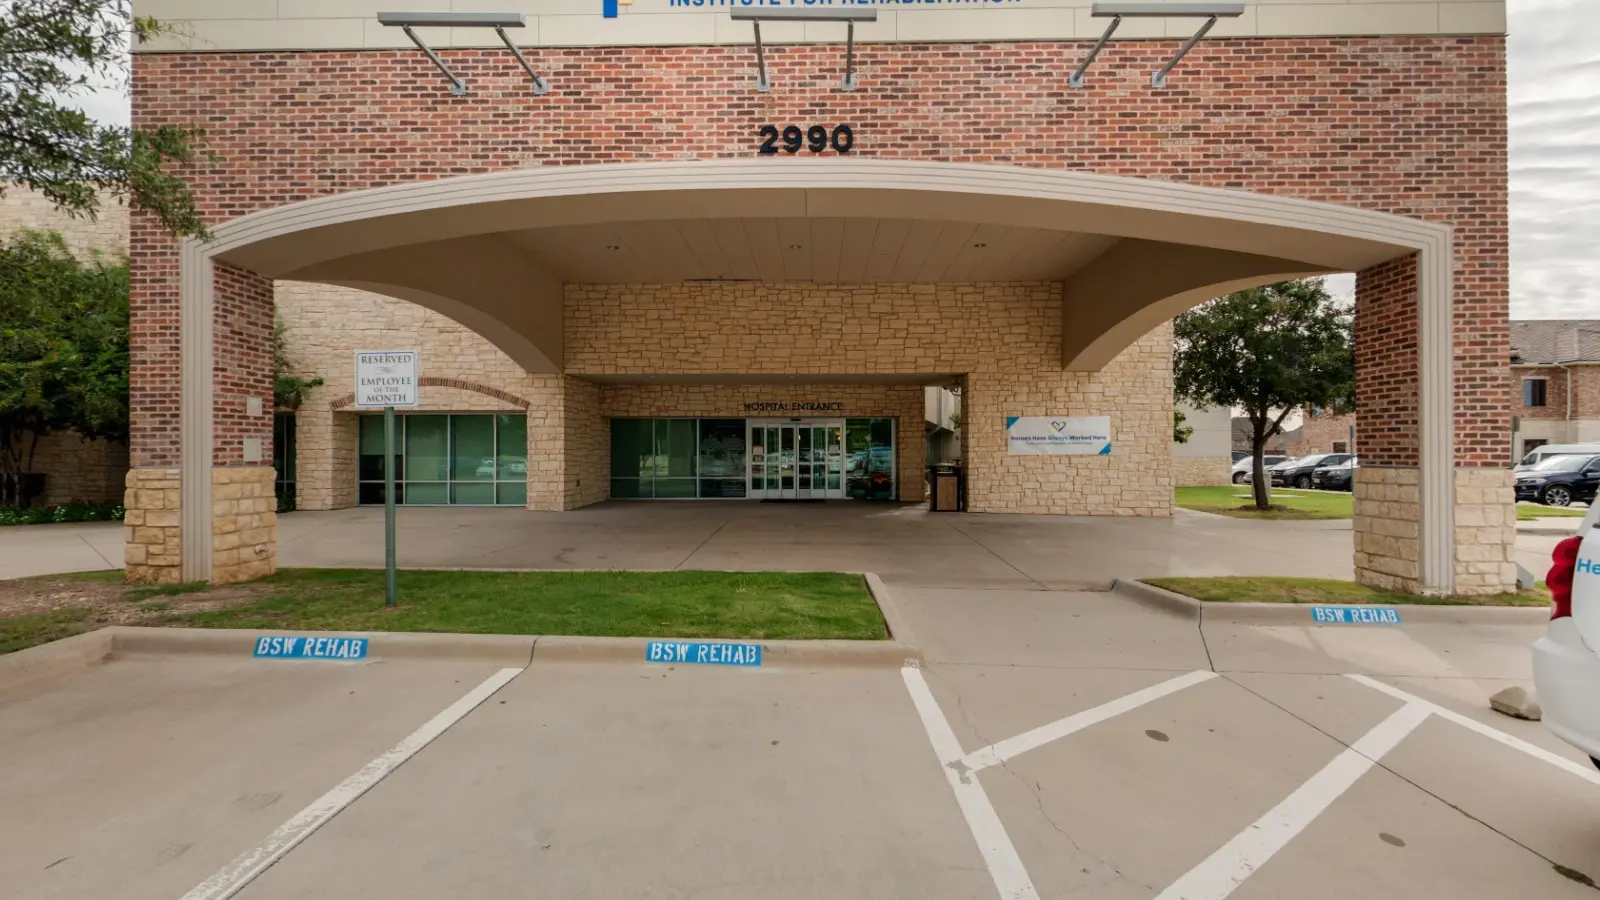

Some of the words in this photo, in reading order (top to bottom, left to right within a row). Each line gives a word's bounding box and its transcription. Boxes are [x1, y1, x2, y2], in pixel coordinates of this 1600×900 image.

[759, 125, 853, 153] 2990
[361, 355, 412, 364] RESERVED
[361, 377, 412, 386] EMPLOYEE
[366, 394, 407, 402] MONTH
[744, 403, 789, 411] HOSPITAL
[791, 403, 844, 411] ENTRANCE
[1315, 607, 1345, 622] BSW
[1351, 608, 1398, 623] REHAB
[257, 637, 297, 655] BSW
[302, 638, 363, 658] REHAB
[650, 642, 689, 662] BSW
[697, 643, 757, 664] REHAB
